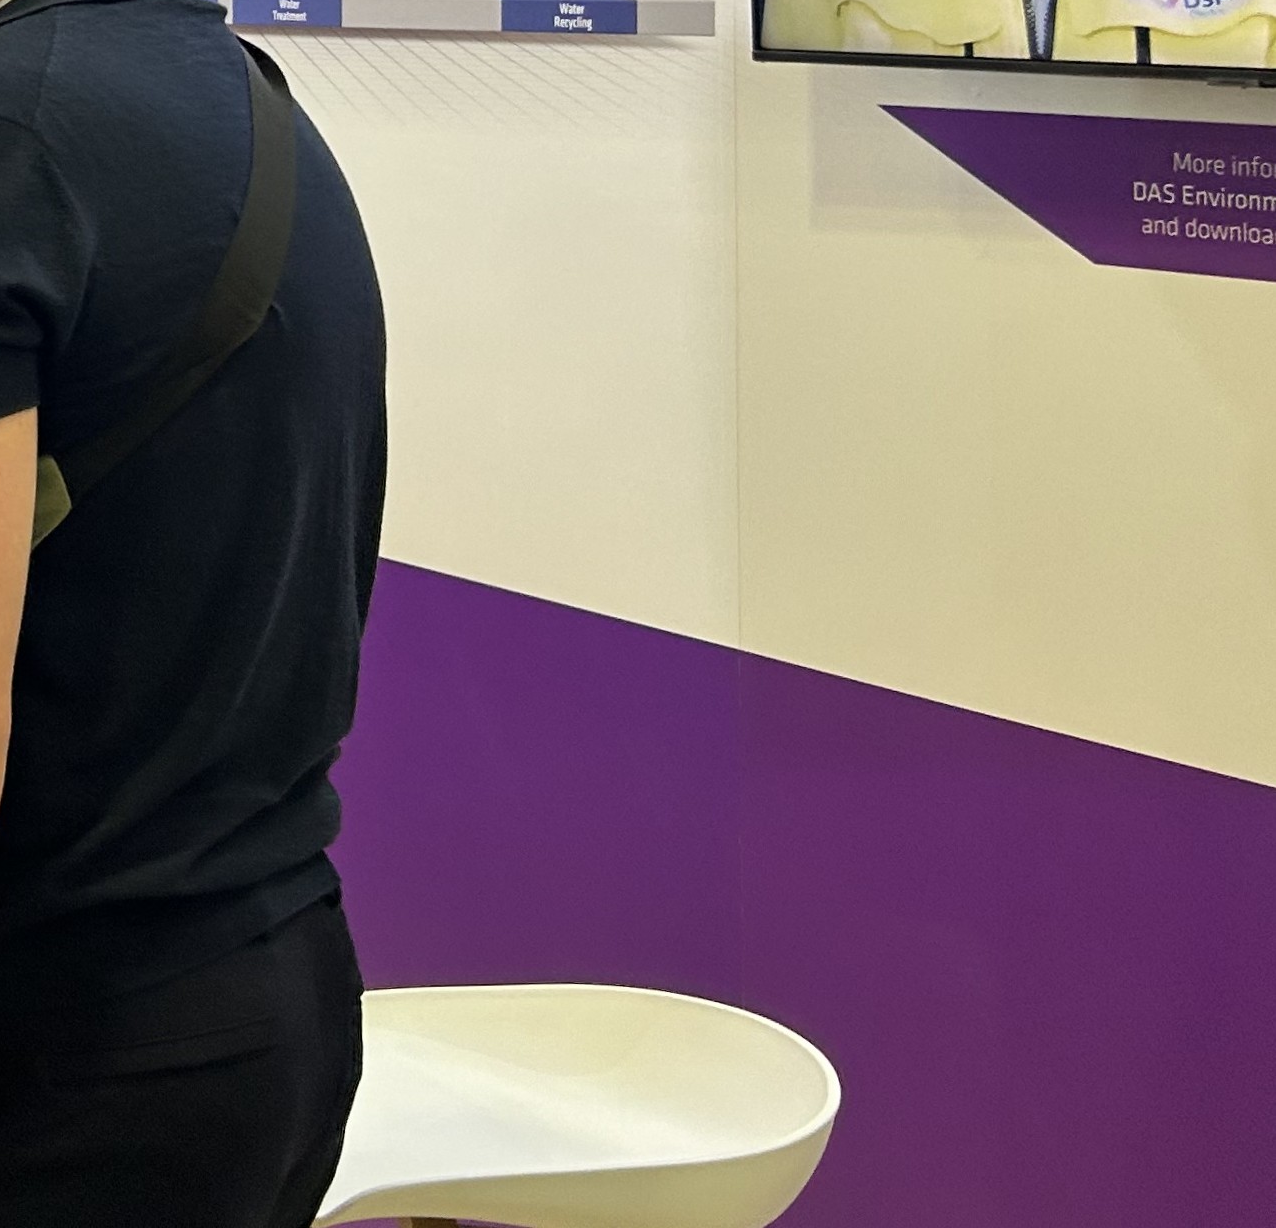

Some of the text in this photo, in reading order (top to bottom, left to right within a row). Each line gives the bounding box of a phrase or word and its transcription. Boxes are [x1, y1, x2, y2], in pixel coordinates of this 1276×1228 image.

[272, 10, 308, 22] Treatment
[559, 3, 585, 15] Water
[553, 15, 593, 31] Recycling
[1172, 151, 1226, 176] More
[1132, 180, 1175, 204] DAS
[1141, 216, 1179, 237] and
